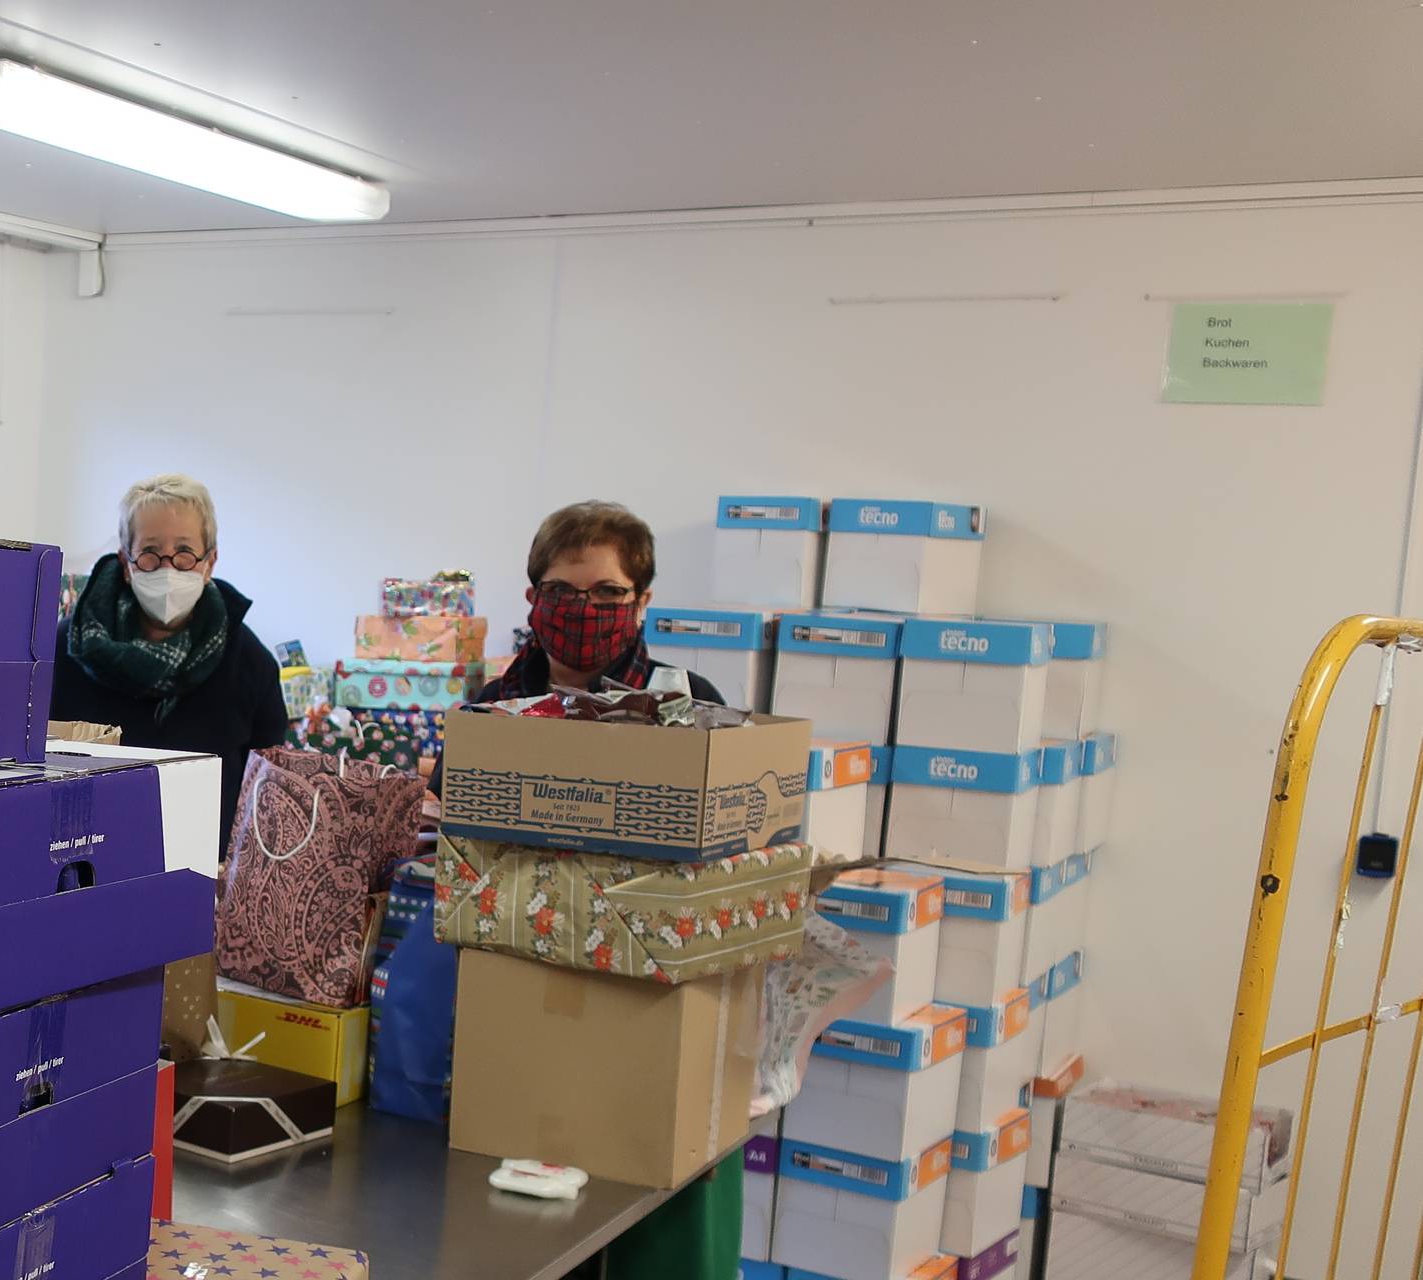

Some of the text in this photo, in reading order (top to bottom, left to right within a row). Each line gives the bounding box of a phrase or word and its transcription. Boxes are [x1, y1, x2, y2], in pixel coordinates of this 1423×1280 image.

[1207, 317, 1232, 328] Brot
[1205, 337, 1250, 349] Kuchen
[1202, 357, 1268, 369] Backwaren
[860, 507, 898, 526] tecno
[940, 630, 989, 652] tecno
[929, 757, 979, 780] tecno
[529, 782, 608, 805] Westfalia
[530, 809, 604, 827] Made in Germany
[49, 840, 69, 851] ziehen
[74, 836, 86, 849] pull
[91, 833, 105, 844] tirer
[283, 1011, 324, 1029] DHL
[15, 1068, 33, 1082] ziehen
[37, 1060, 49, 1075] pull
[52, 1056, 65, 1068] tirer
[748, 1150, 767, 1164] A4
[42, 1260, 55, 1273] tirer
